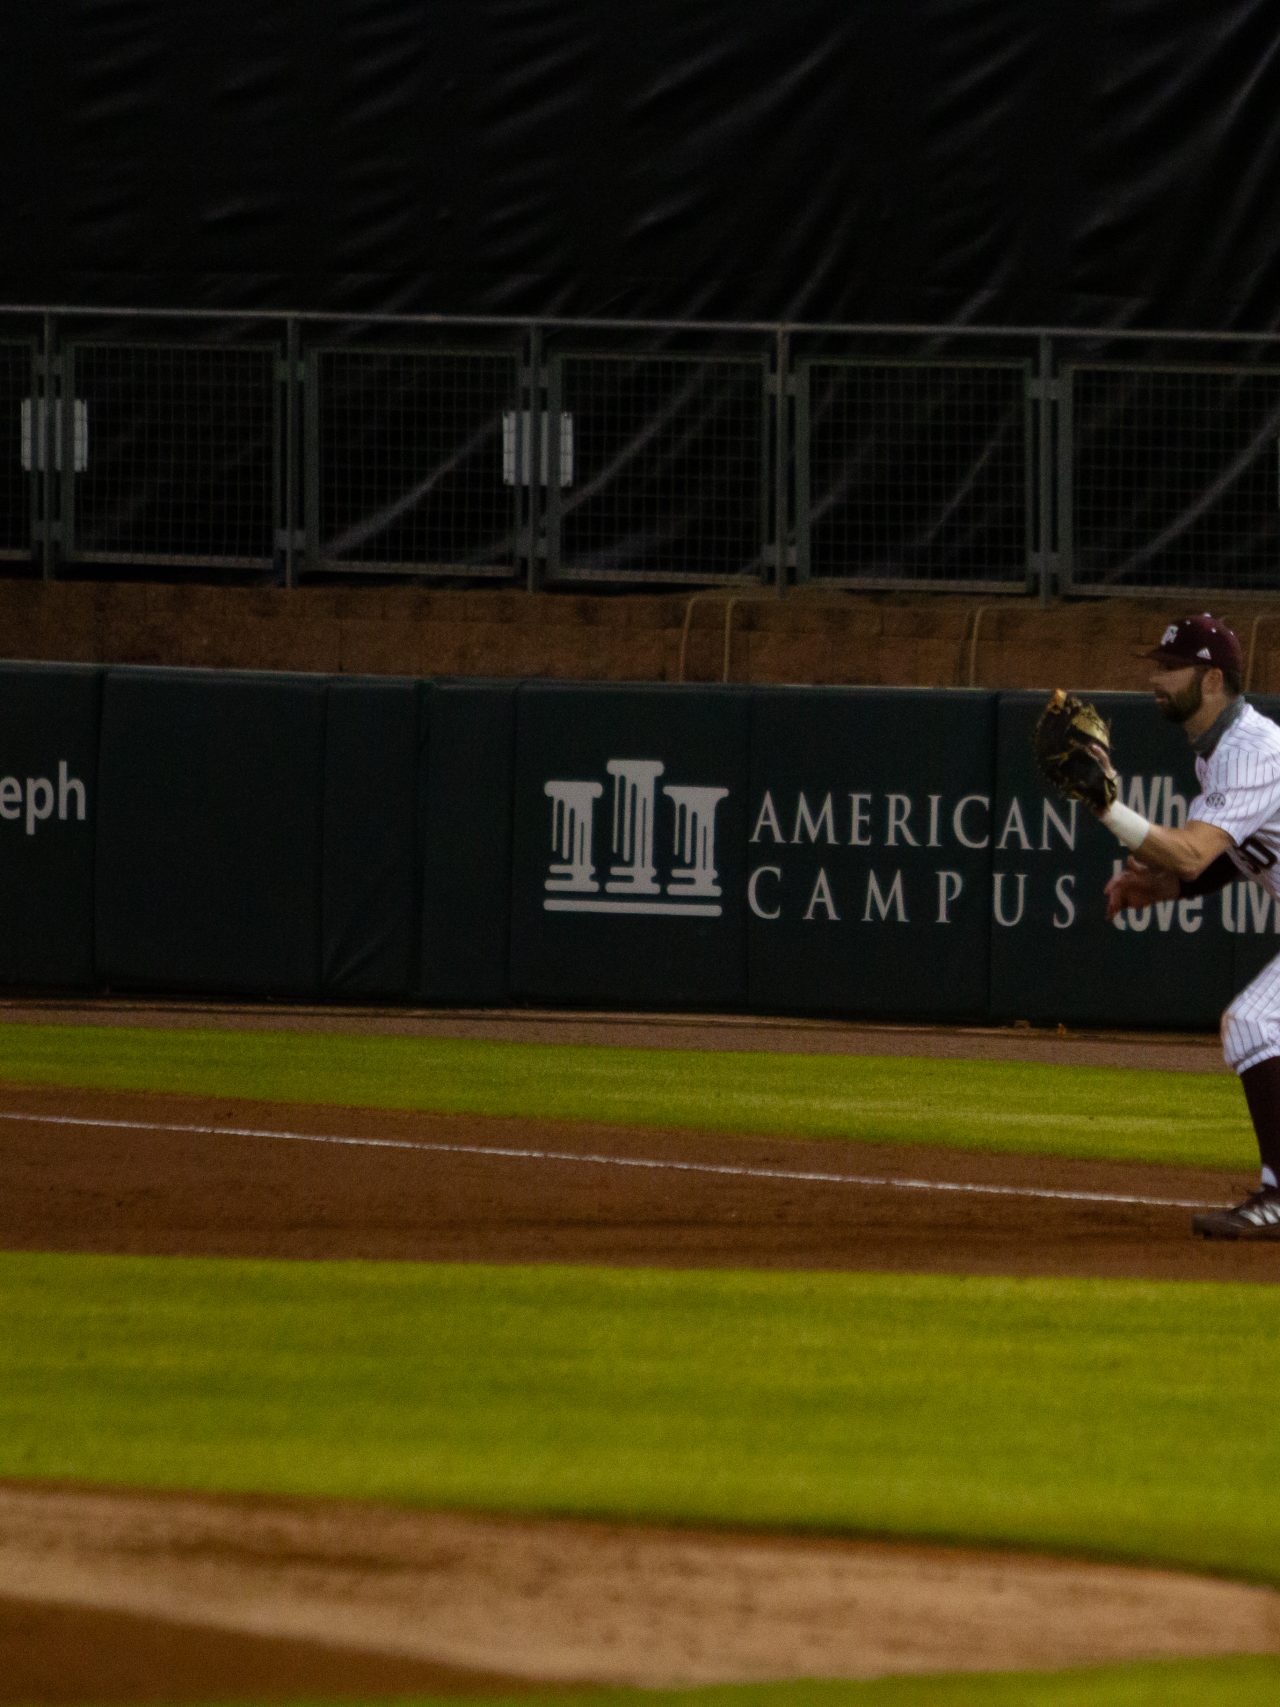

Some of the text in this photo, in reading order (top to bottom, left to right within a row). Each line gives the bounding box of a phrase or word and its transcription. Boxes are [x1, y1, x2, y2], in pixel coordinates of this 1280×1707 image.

[0, 760, 86, 836] eph
[748, 790, 1080, 852] AMERICAN
[747, 864, 1077, 930] CAMPUS
